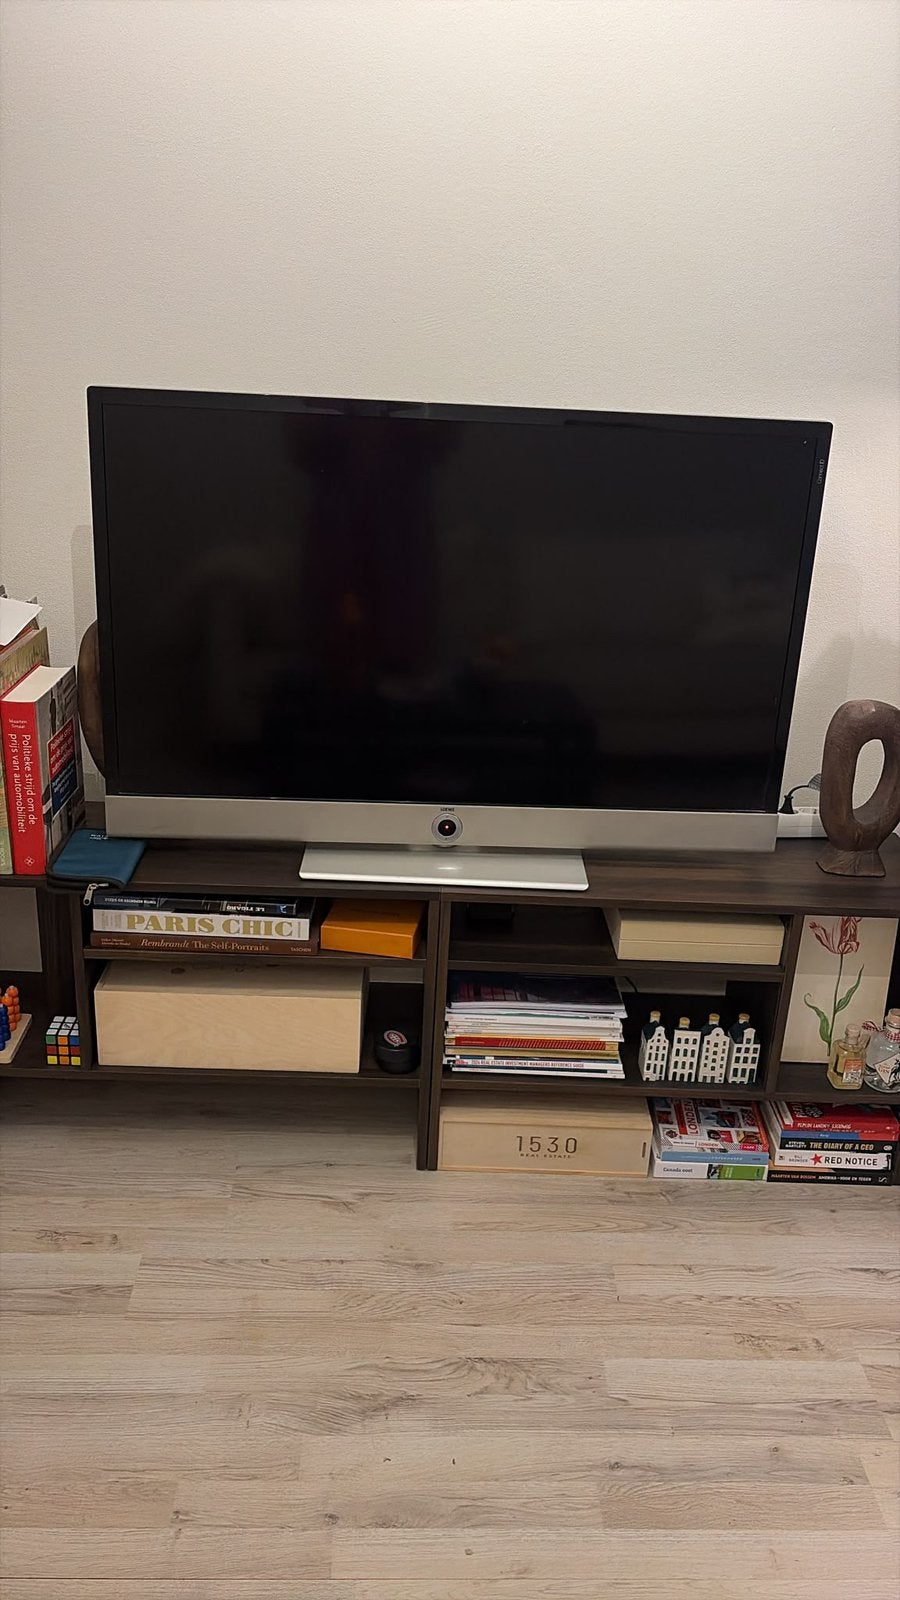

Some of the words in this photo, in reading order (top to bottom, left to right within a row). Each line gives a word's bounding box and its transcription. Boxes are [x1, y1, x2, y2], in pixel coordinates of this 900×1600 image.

[8, 733, 20, 753] prijs
[22, 734, 33, 772] Politieke
[12, 755, 20, 771] van
[24, 773, 37, 796] strijd
[13, 772, 26, 833] automobiliteit
[28, 797, 35, 812] om
[28, 813, 38, 825] de
[126, 914, 215, 934] PARIS
[222, 918, 293, 937] CHIC
[140, 938, 189, 948] Rembrandt
[191, 940, 210, 949] The
[210, 941, 270, 951] Self-Portraits
[516, 1135, 578, 1154] 1530
[823, 1142, 844, 1150] DIARY
[860, 1143, 875, 1151] CEO
[824, 1156, 842, 1165] RED
[845, 1157, 878, 1166] NOTICE
